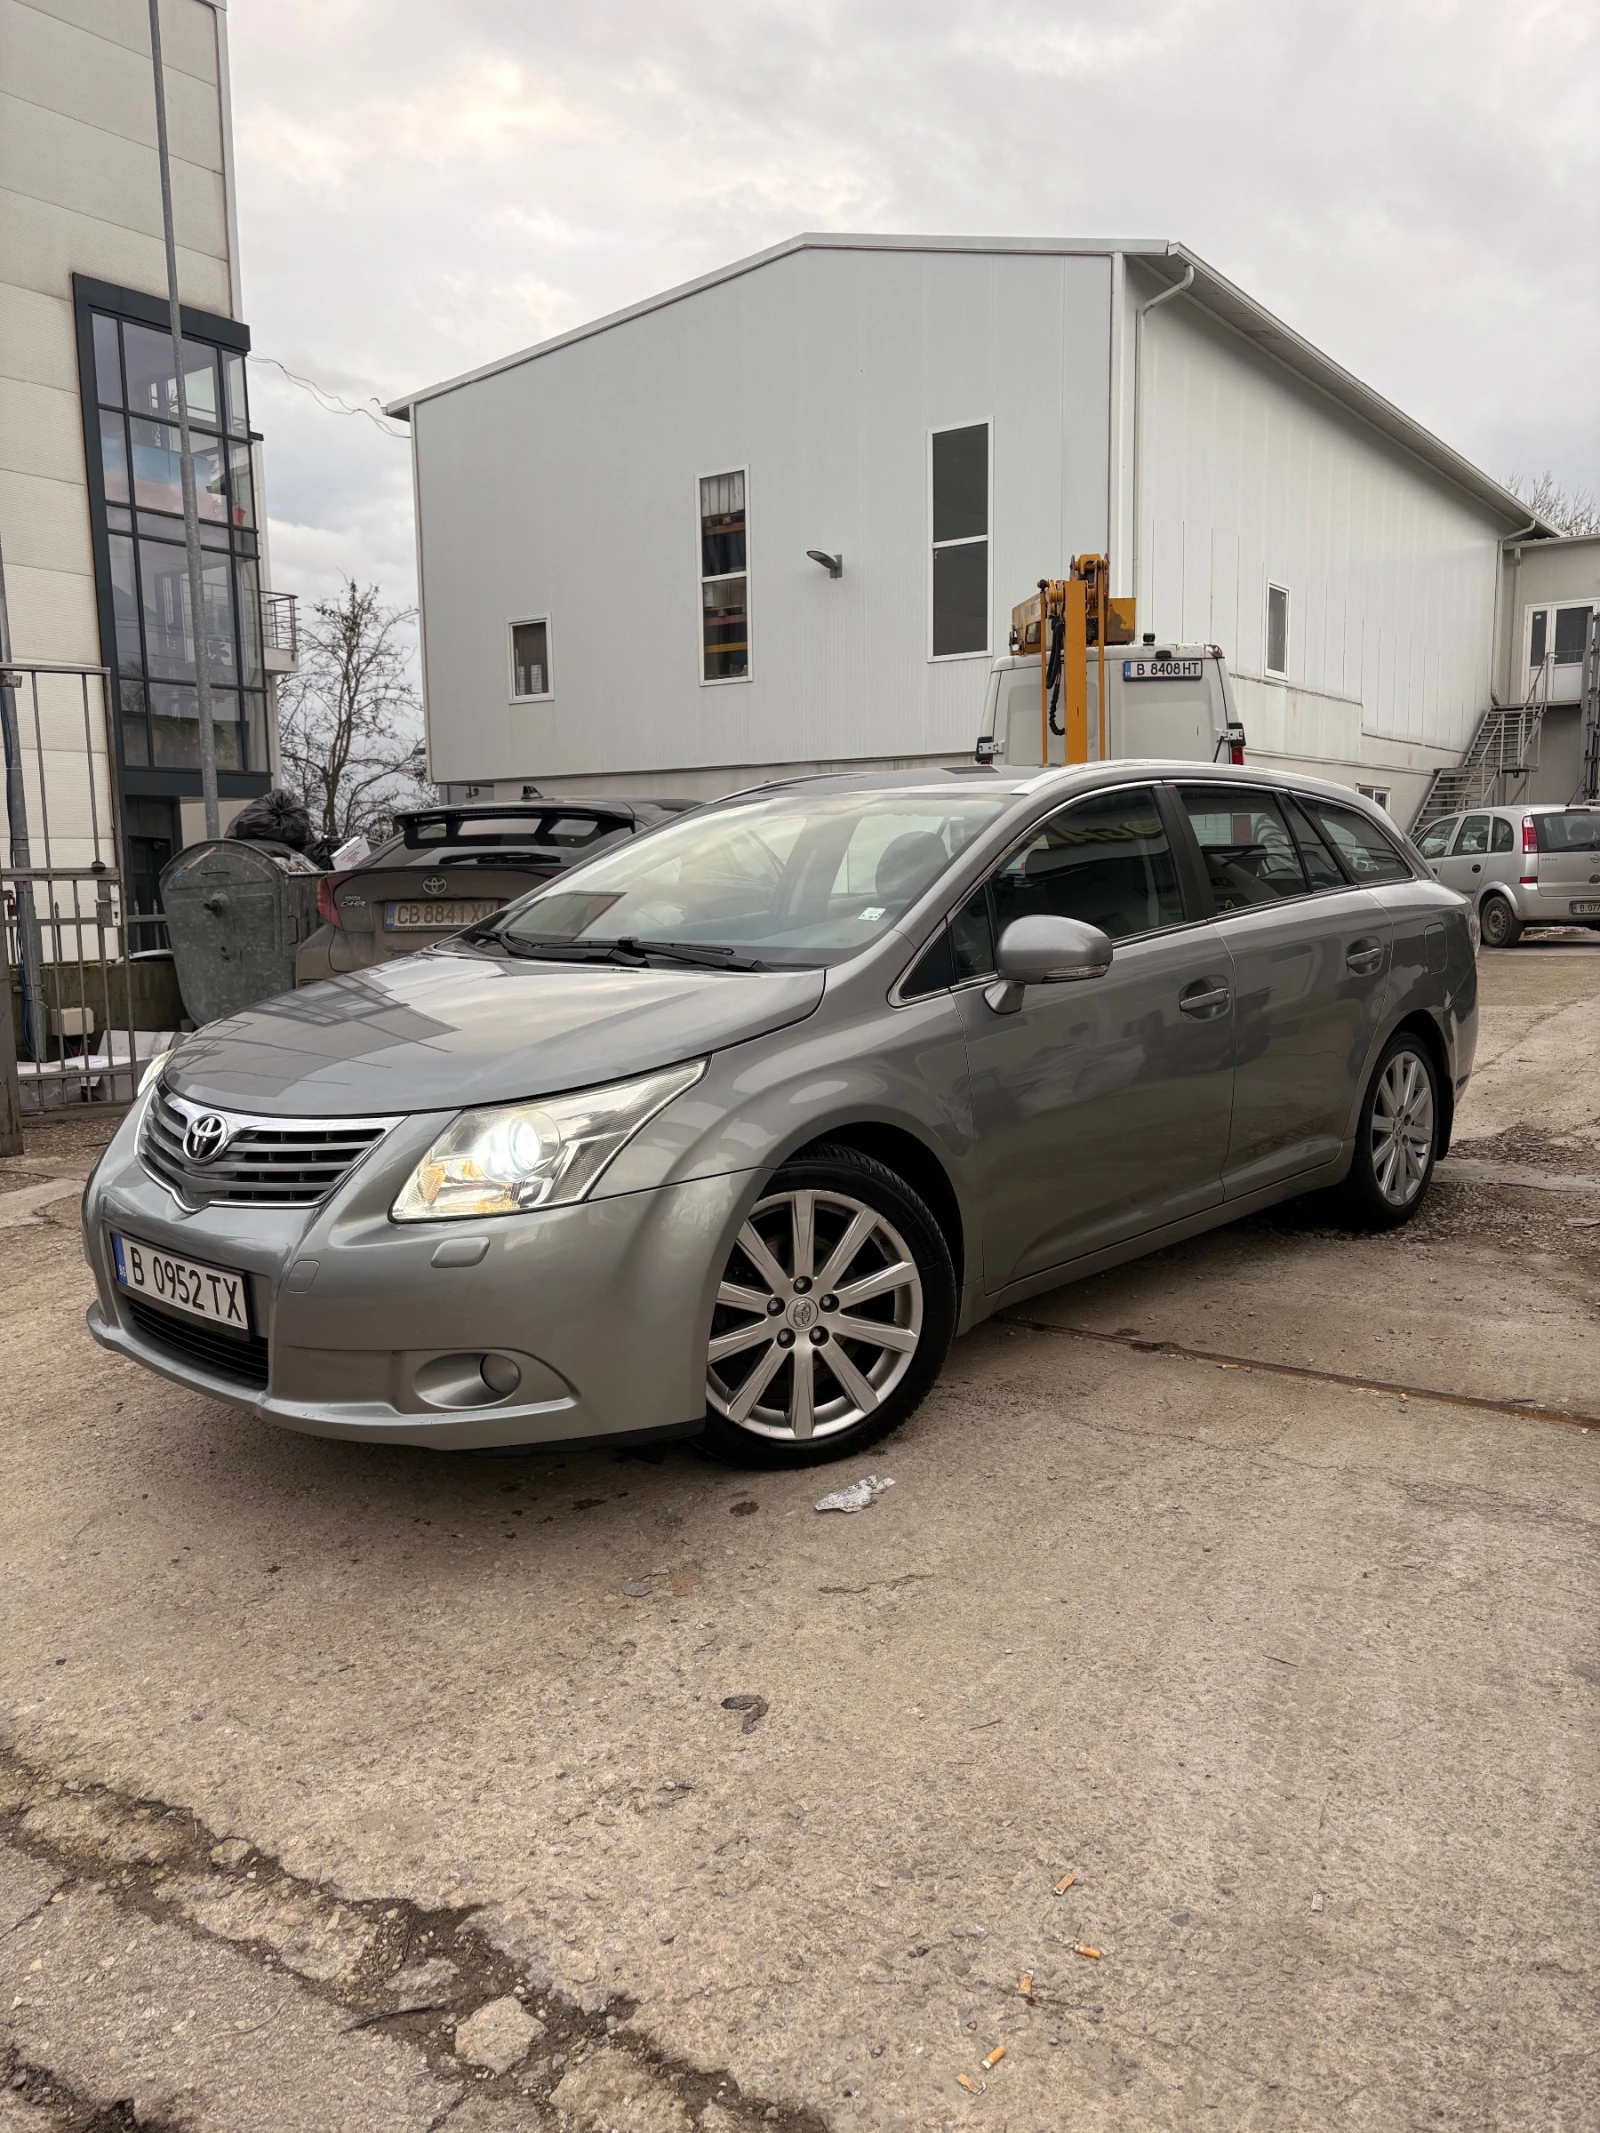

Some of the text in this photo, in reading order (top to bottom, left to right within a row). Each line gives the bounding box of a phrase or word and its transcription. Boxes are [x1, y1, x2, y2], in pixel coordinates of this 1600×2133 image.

[1136, 663, 1145, 676] B
[340, 900, 366, 908] C-HR
[397, 905, 420, 924] CB
[423, 904, 466, 924] 8841
[130, 1246, 145, 1286] B
